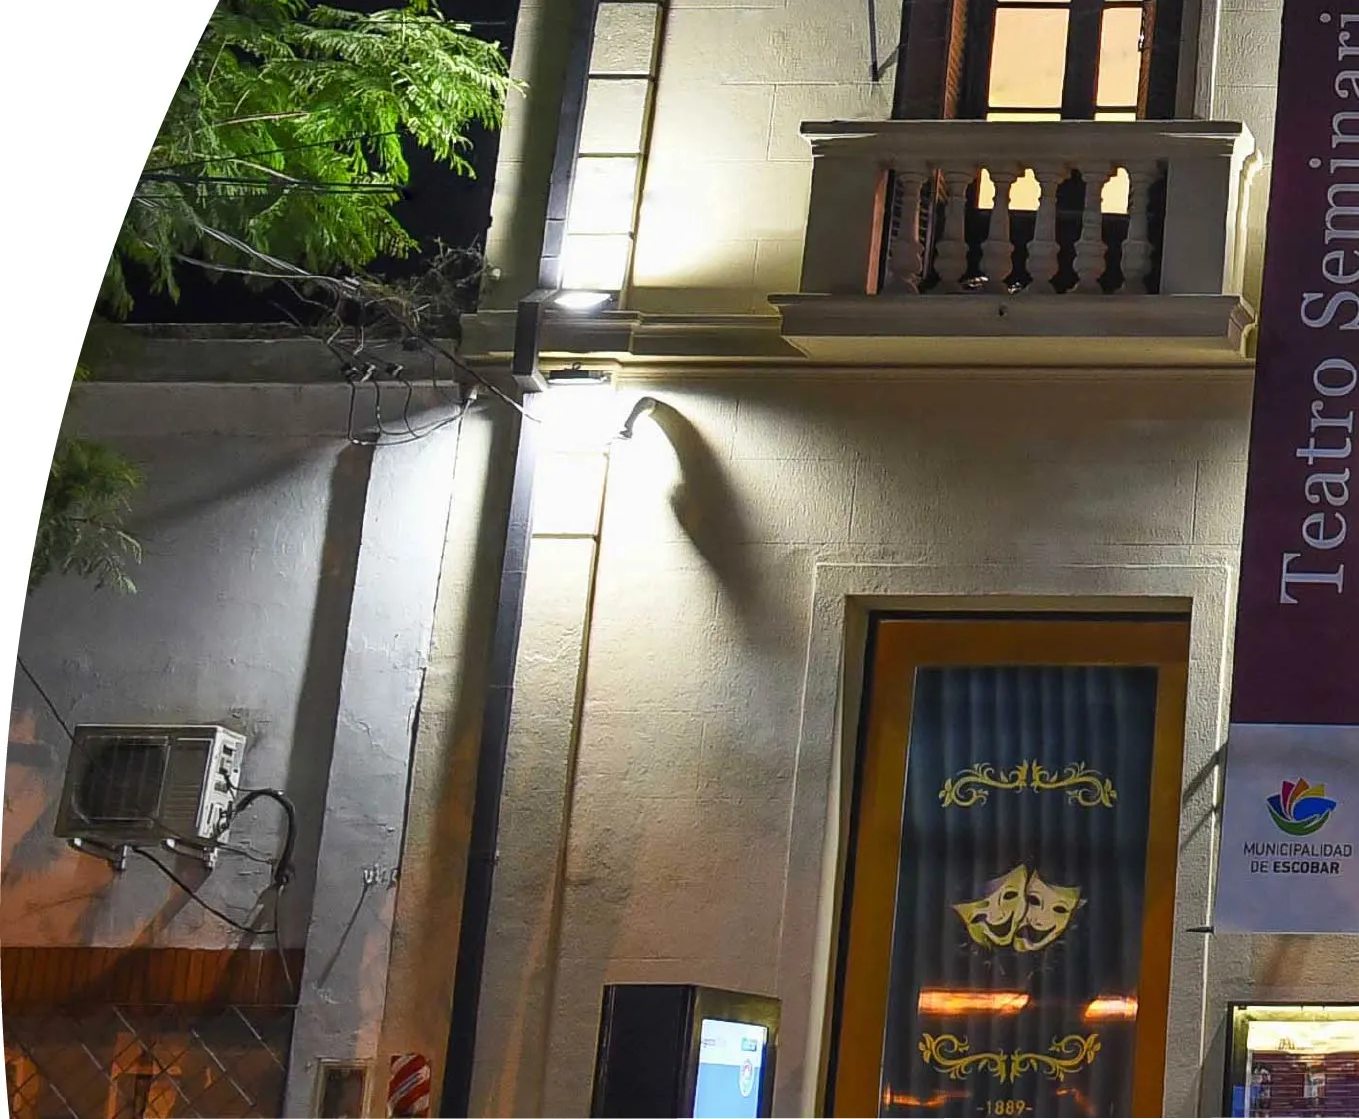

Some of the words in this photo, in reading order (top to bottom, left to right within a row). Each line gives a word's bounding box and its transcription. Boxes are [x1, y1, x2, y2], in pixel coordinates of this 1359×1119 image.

[1280, 358, 1357, 605] Teatro
[1243, 842, 1353, 858] MUNICIPALIDAD
[1251, 861, 1269, 874] DE
[1273, 861, 1340, 875] ESCOBAR
